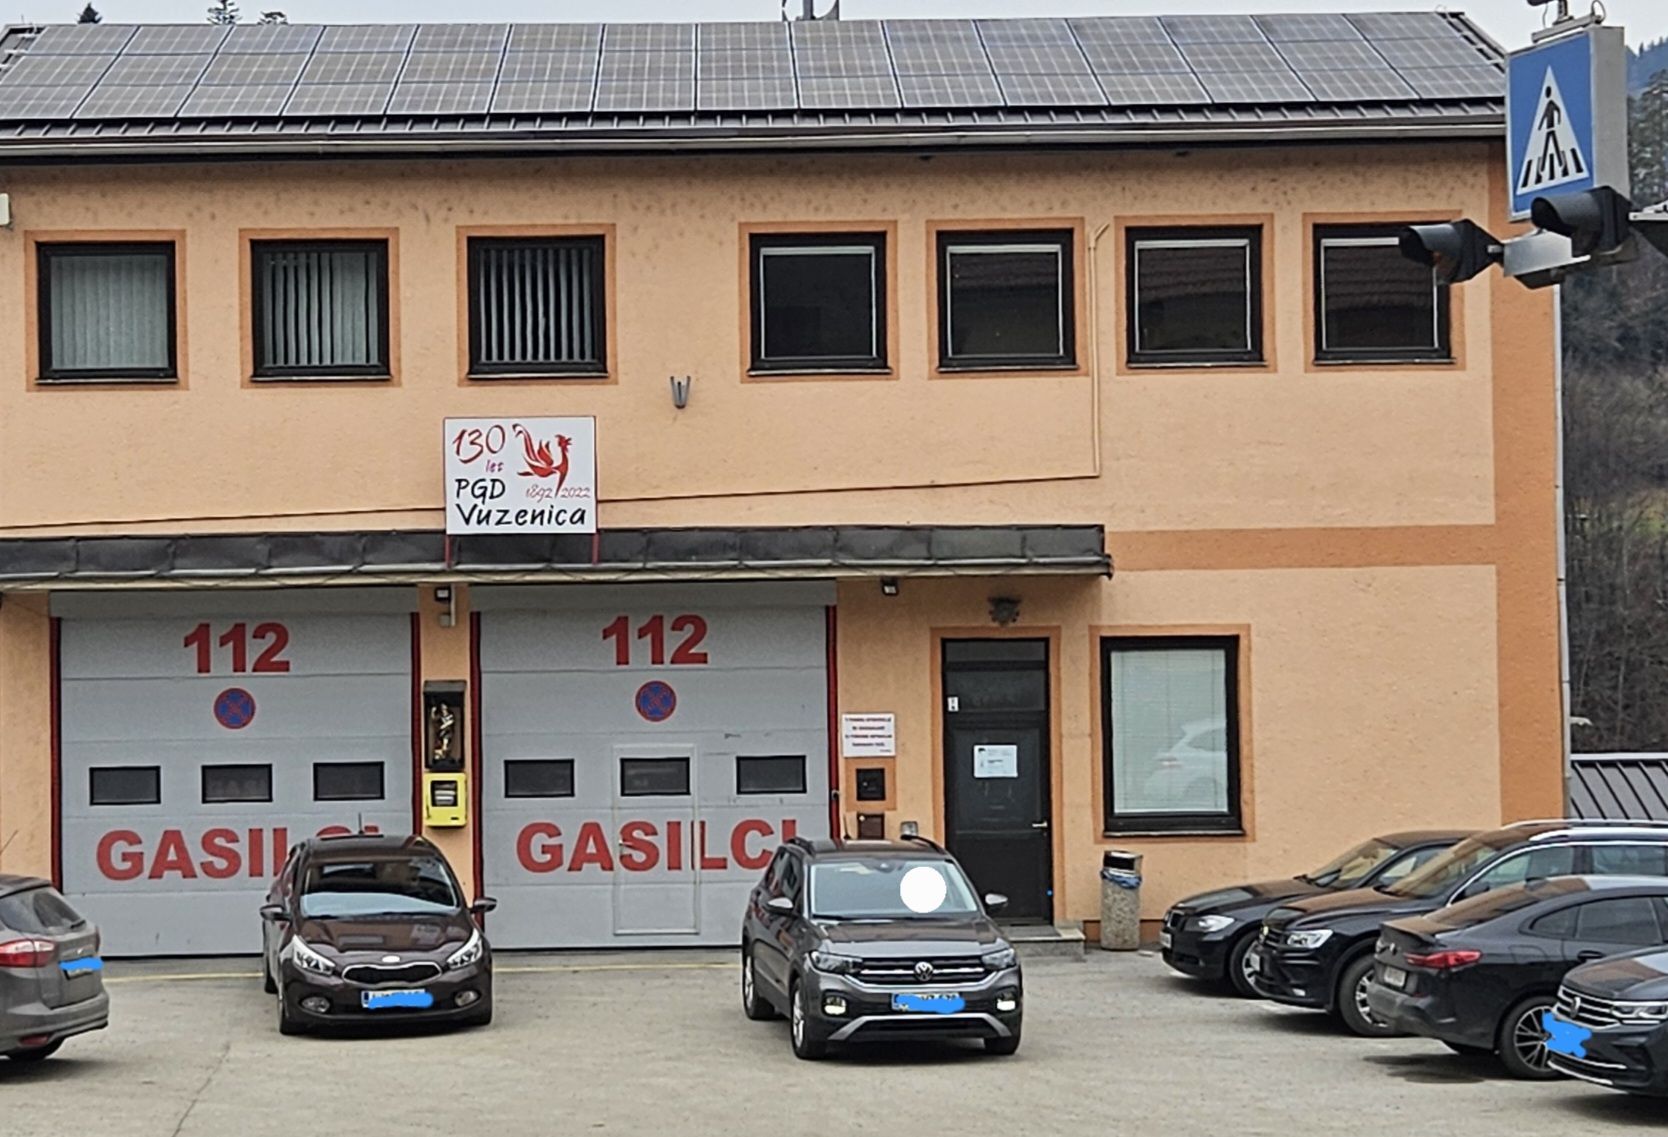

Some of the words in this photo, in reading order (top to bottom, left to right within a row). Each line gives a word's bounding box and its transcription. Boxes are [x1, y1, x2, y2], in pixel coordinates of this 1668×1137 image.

[452, 424, 506, 465] 130
[486, 459, 504, 473] let
[454, 478, 506, 505] PGD
[526, 484, 553, 503] 1892
[560, 486, 591, 499] 2022
[455, 503, 587, 527] Vuzenica
[183, 622, 291, 674] 112
[602, 614, 708, 666] 112
